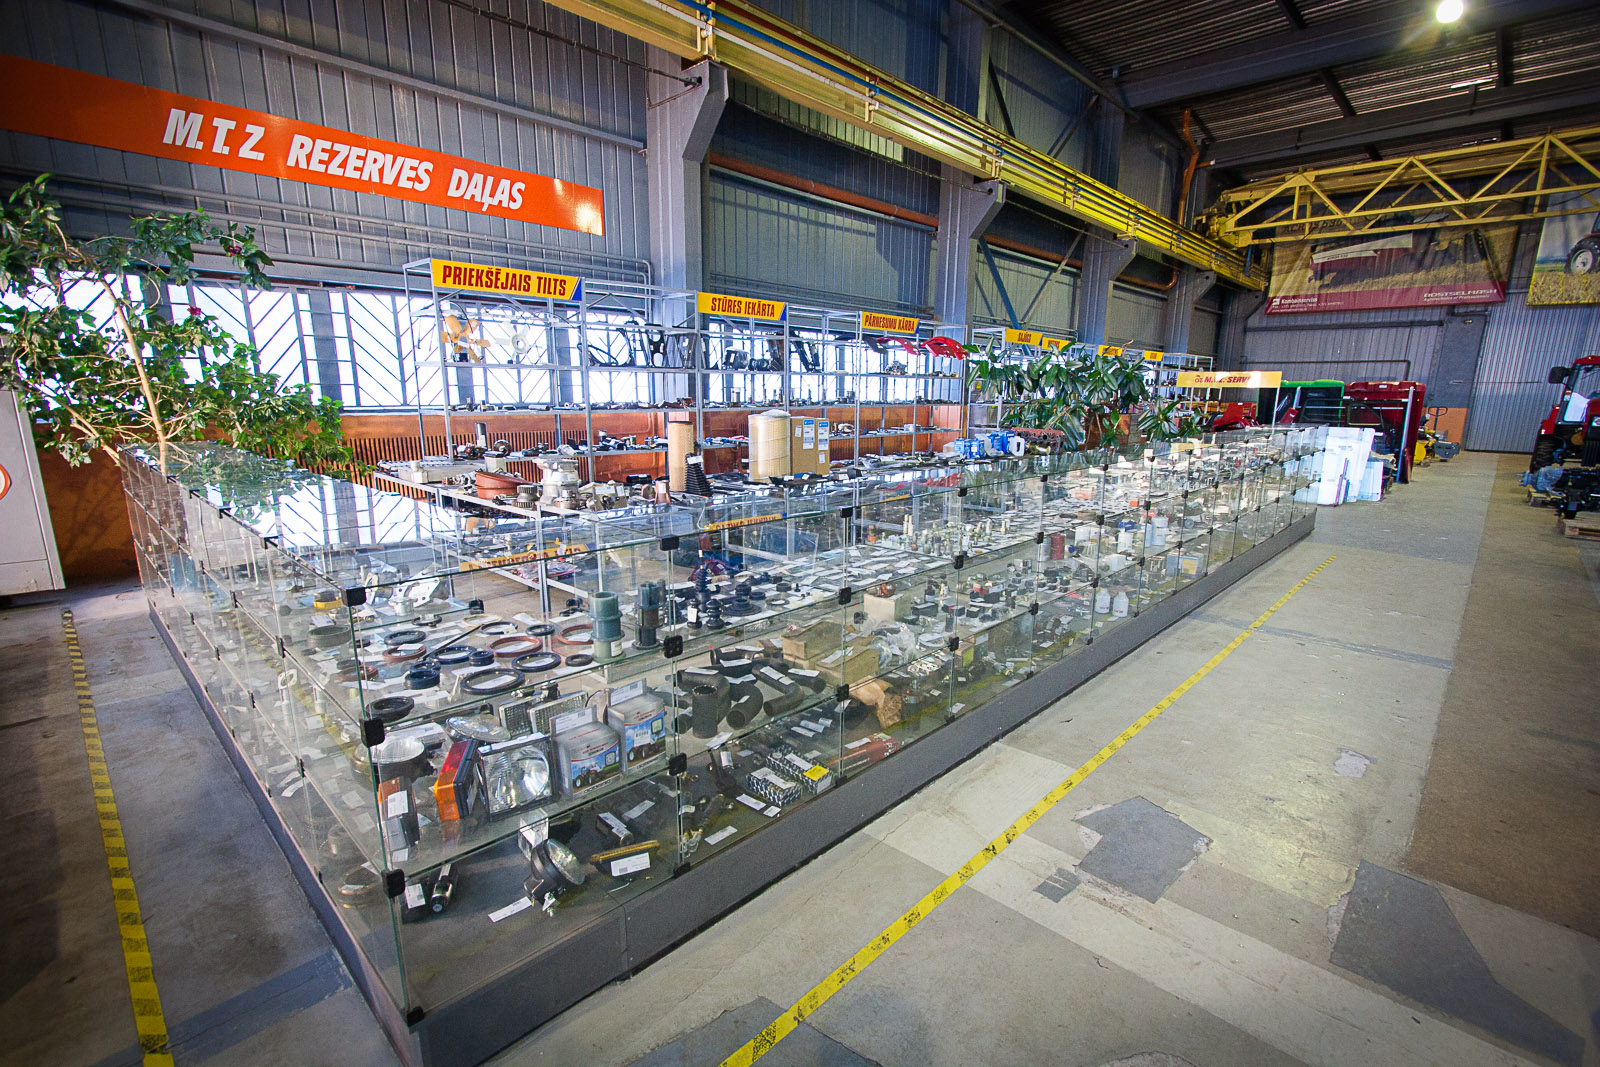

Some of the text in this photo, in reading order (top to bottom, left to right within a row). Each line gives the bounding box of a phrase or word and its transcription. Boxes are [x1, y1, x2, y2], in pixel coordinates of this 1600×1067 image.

[286, 134, 434, 192] REZERVES
[447, 168, 526, 211] DAĻAS
[442, 264, 567, 296] PRIEKŠĒJAIS TILTS
[711, 296, 775, 317] STŪRES IEKĀRTA
